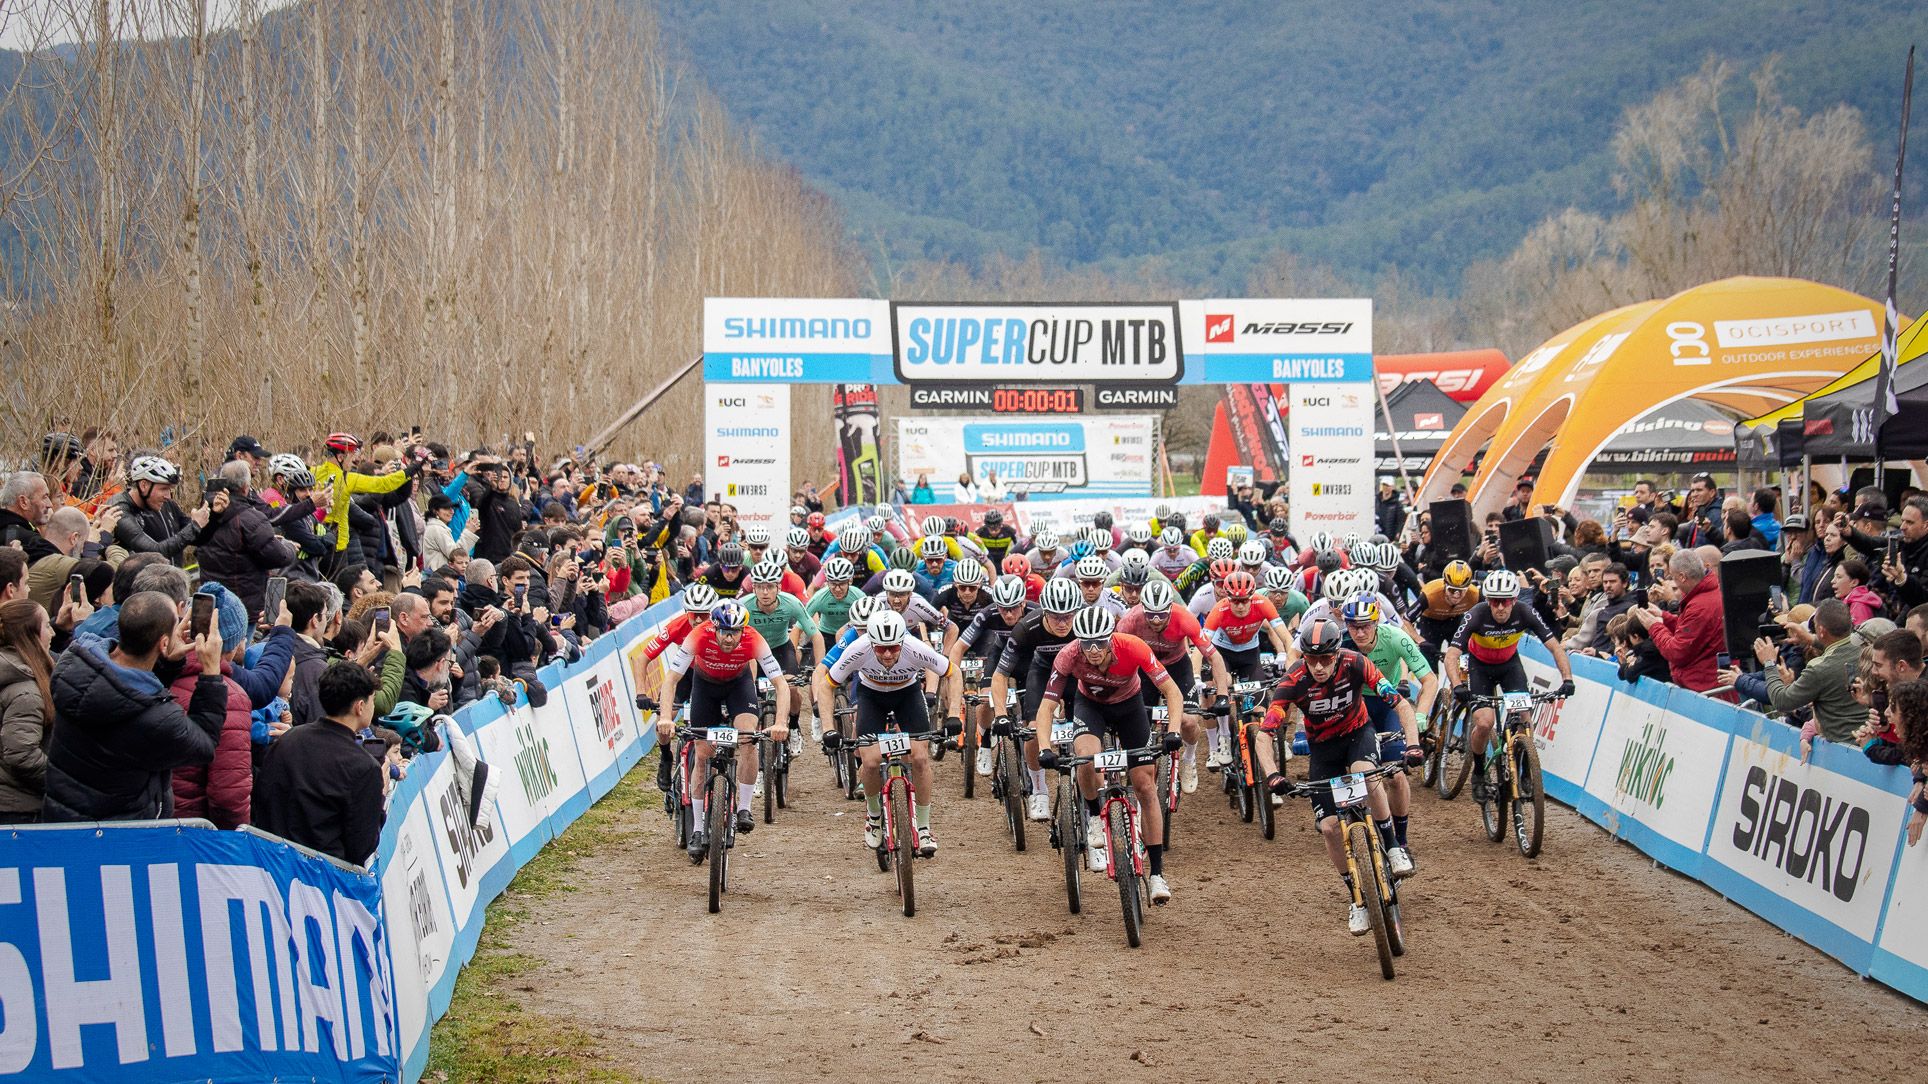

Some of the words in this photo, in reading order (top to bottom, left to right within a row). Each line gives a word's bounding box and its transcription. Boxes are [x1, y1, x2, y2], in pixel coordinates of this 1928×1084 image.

[724, 317, 872, 340] SHIMANO
[1728, 317, 1860, 340] OCISPORT
[906, 316, 1093, 366] SUPERCUP
[1101, 318, 1166, 366] MTB
[1721, 352, 1786, 364] OUTDOOR
[1789, 343, 1882, 360] EXPERIENCES
[731, 357, 805, 378] BANYOLES
[1272, 358, 1345, 379] BANYOLES
[723, 398, 747, 408] UCI
[993, 390, 1080, 413] 00:00:01
[1307, 397, 1330, 408] UCI
[716, 426, 779, 438] SHIMANO
[1300, 426, 1364, 438] SHIMANO
[1619, 417, 1702, 434] iking
[981, 432, 1071, 447] SHIMANO
[979, 460, 1050, 480] SUPERCUP
[1052, 460, 1078, 479] MTB
[736, 511, 774, 521] werbar
[1303, 510, 1358, 522] Powerbar
[753, 616, 784, 625] BIXS
[839, 651, 865, 672] CANYON
[1239, 682, 1257, 690] 192
[1308, 689, 1353, 712] BH
[1510, 699, 1527, 708] 281
[1158, 709, 1170, 718] 12
[713, 732, 734, 742] 146
[1053, 731, 1074, 740] 136
[884, 739, 906, 751] 131
[1100, 754, 1122, 766] 127
[1615, 722, 1675, 810] wikiloc
[1345, 786, 1355, 800] 2
[1732, 765, 1870, 903] SIROKO
[0, 862, 397, 1075] HIMAN
